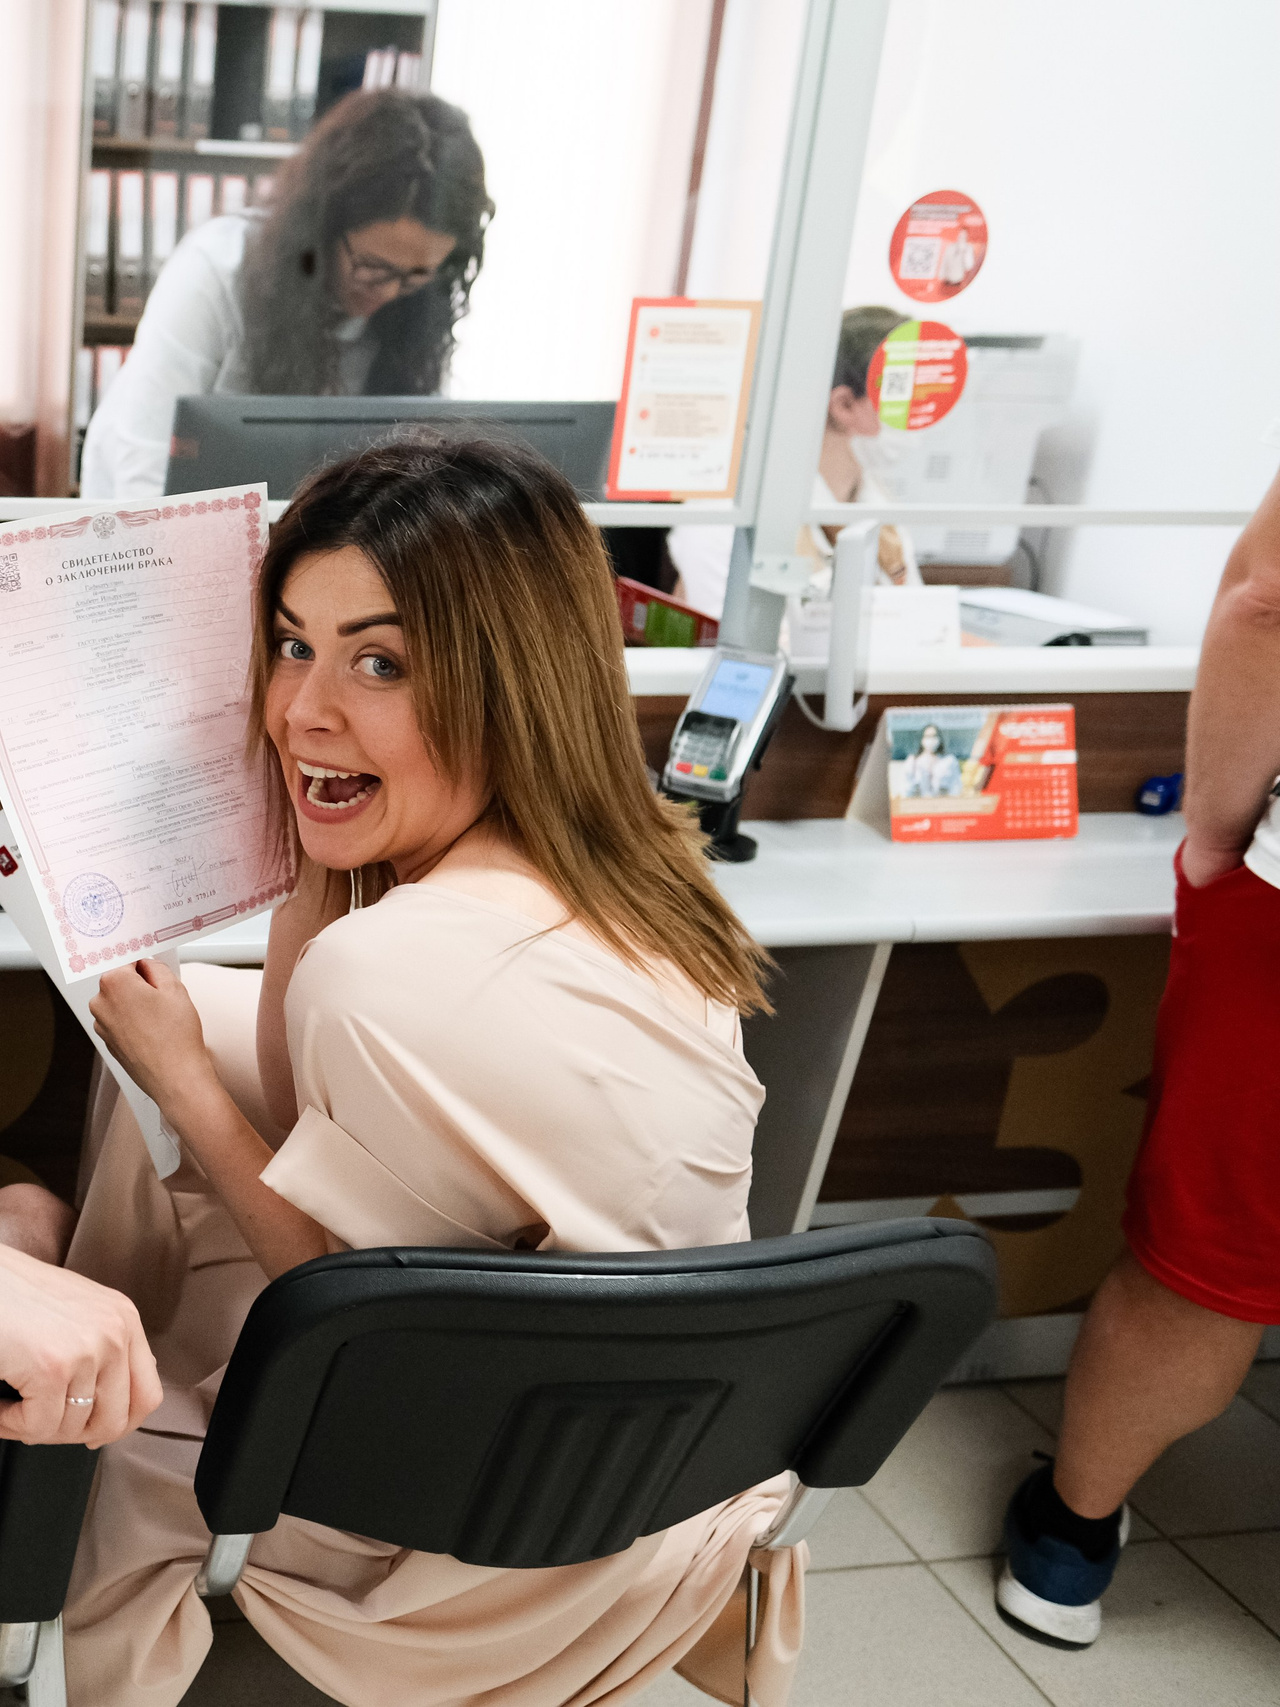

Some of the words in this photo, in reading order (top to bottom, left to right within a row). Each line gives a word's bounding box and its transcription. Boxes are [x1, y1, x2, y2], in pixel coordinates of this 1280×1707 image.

[56, 562, 134, 584] ЗАКЛЮЧЕНИИ
[137, 556, 173, 569] БРАКА
[61, 546, 154, 570] СВИДЕТЕЛЬСТВО
